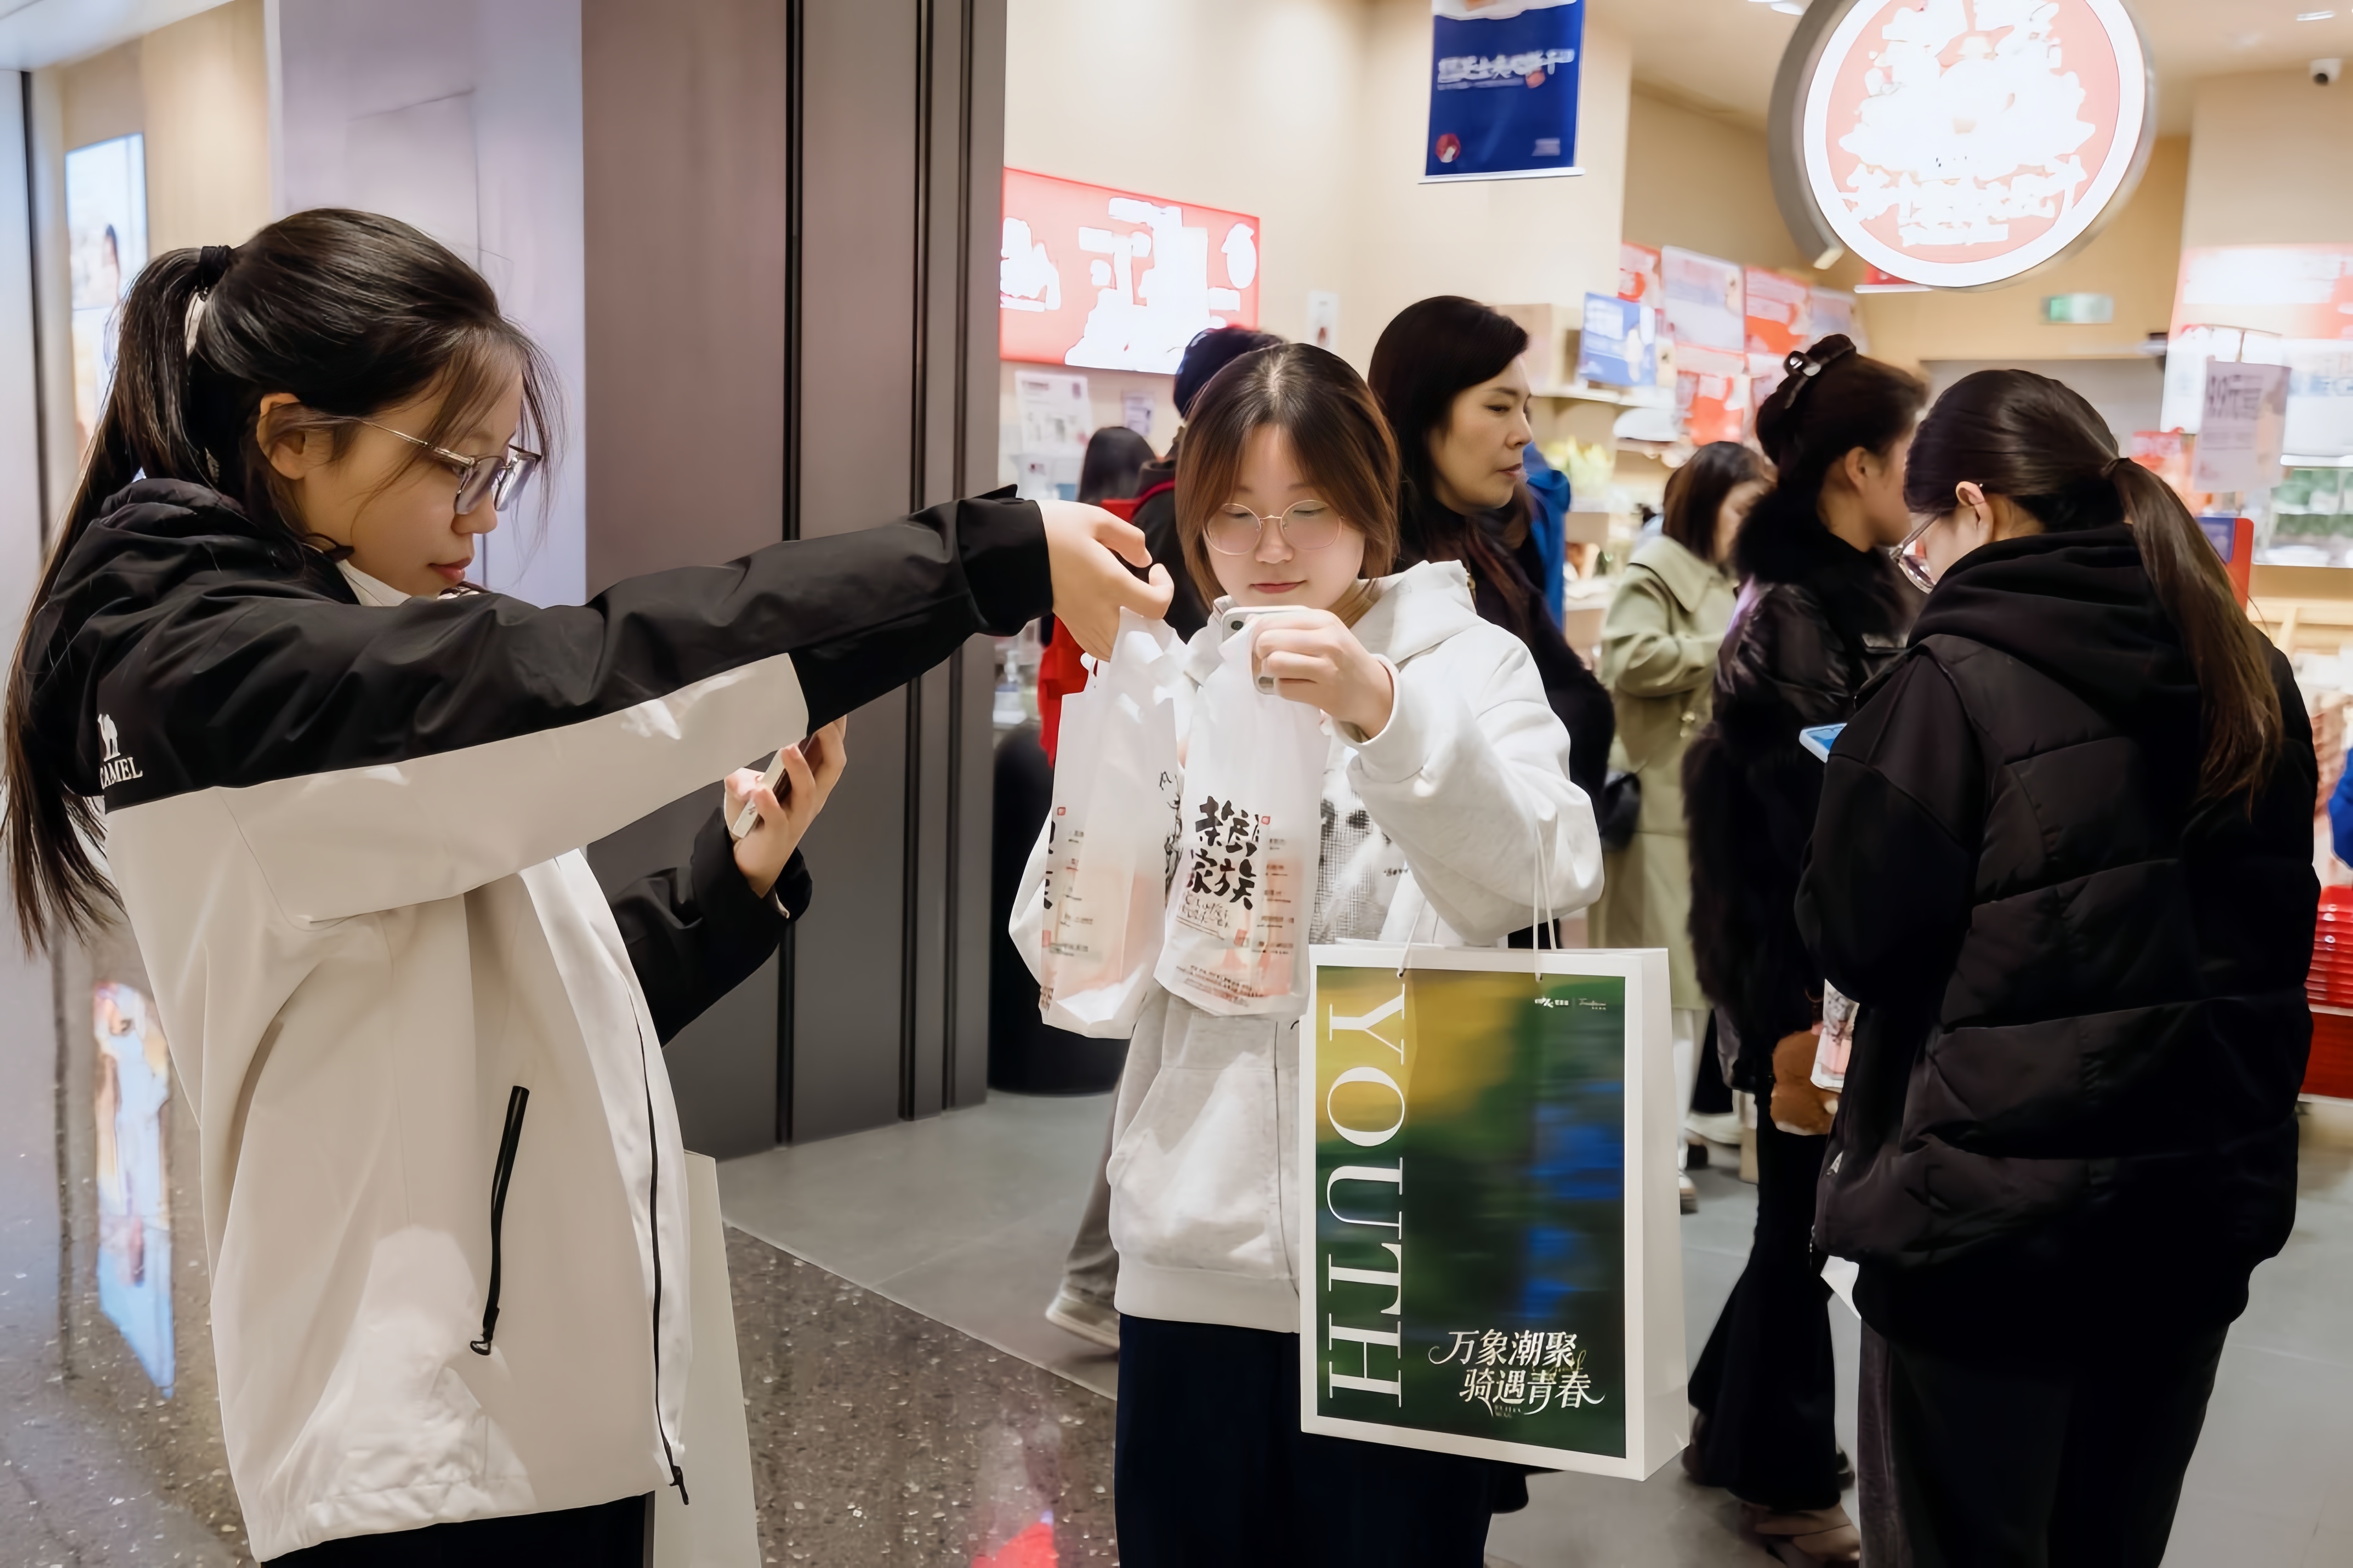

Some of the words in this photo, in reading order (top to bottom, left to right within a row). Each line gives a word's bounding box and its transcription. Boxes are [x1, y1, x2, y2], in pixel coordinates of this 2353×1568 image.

[1326, 983, 1406, 1408] YOUTH
[1428, 1329, 1577, 1368] 万象潮聚
[1459, 1367, 1606, 1417] 骑遇青春
